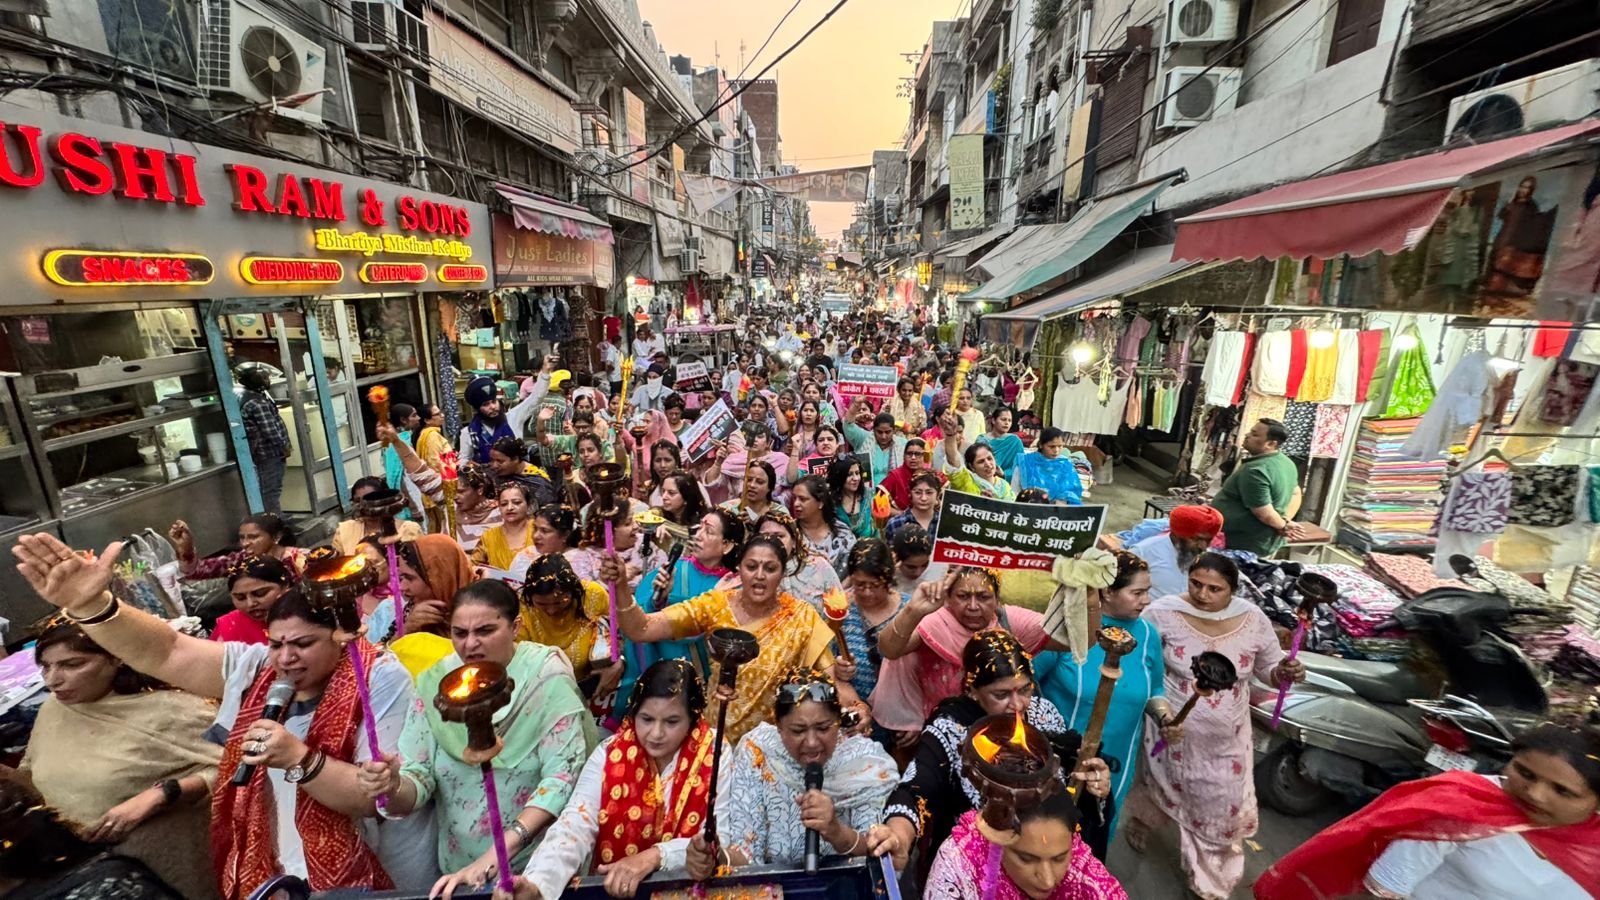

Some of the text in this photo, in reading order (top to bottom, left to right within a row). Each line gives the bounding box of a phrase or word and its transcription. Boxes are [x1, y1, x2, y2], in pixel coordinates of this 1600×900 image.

[229, 163, 346, 221] RAM
[361, 188, 387, 226] &
[398, 195, 471, 237] SONS
[386, 234, 433, 254] Misthan
[434, 239, 450, 256] Ke
[506, 234, 588, 265] Just Ladies
[81, 257, 191, 282] SNACKS
[252, 261, 340, 280] WEDDING BOX
[949, 503, 1095, 532] महिलाओं के अधिकारों
[961, 522, 1075, 551] की जब बारी आई
[943, 548, 994, 564] कांग्रेस
[1000, 554, 1013, 566] है
